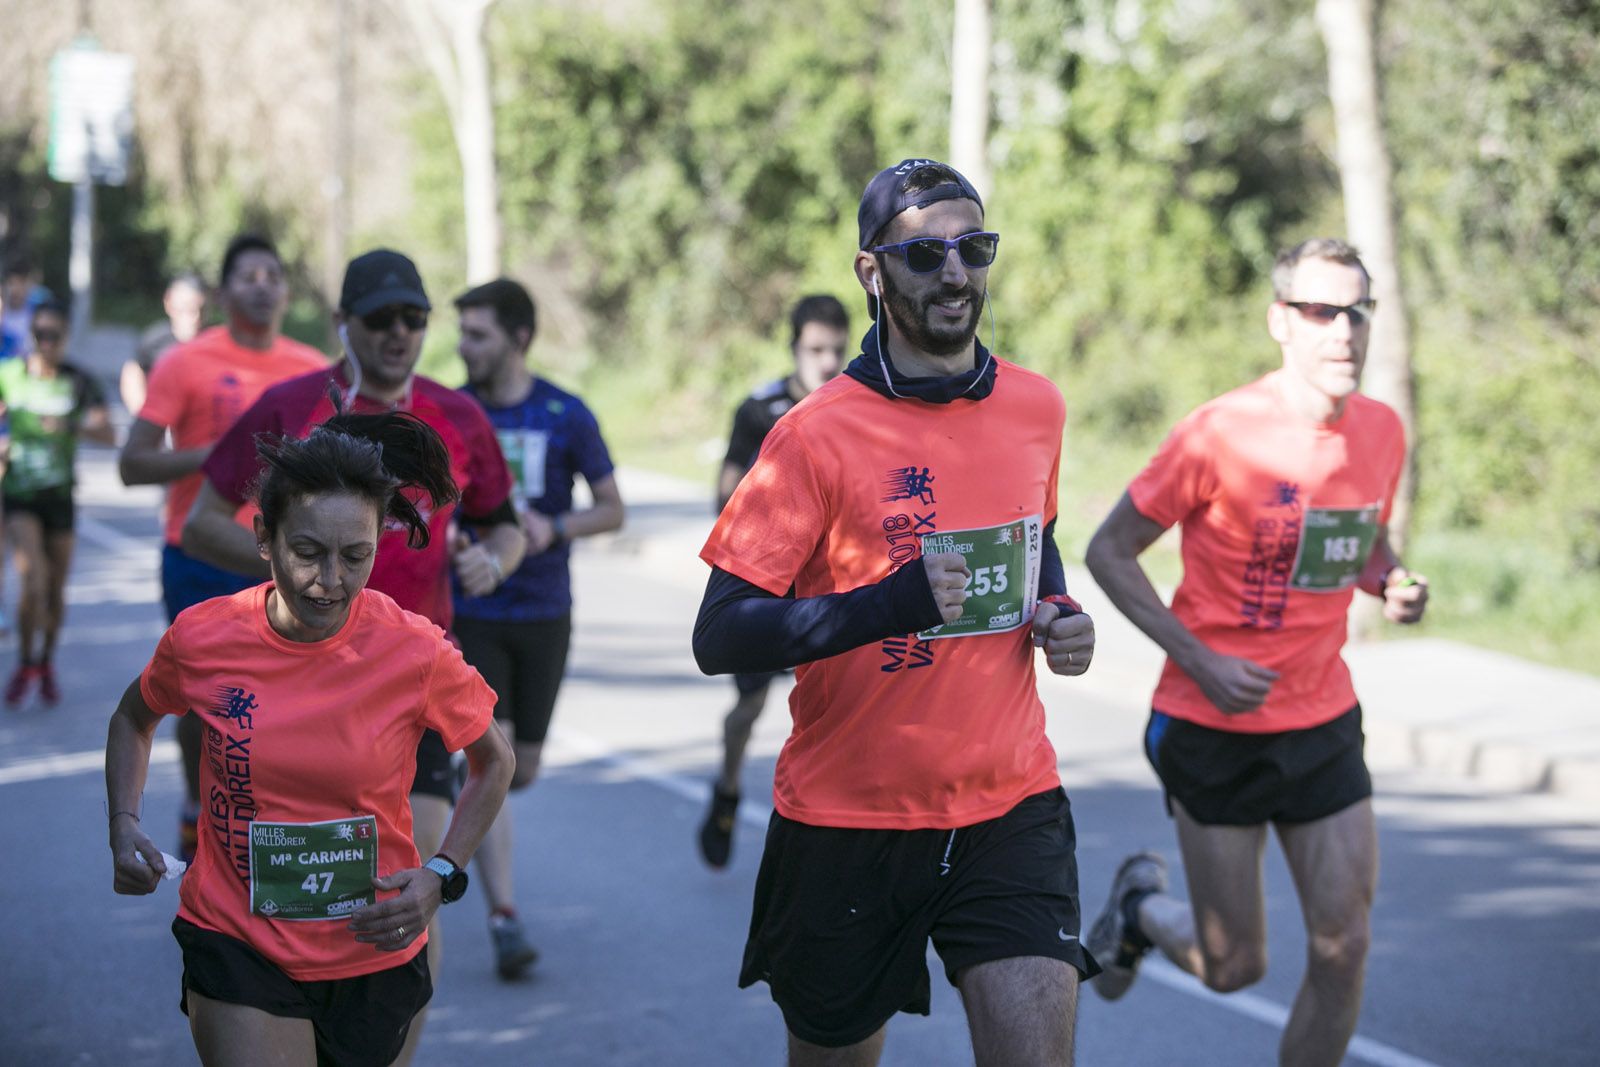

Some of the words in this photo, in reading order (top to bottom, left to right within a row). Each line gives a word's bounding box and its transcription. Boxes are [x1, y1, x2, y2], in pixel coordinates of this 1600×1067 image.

[925, 535, 954, 547] MILLES
[1029, 523, 1038, 552] 253
[1323, 536, 1360, 562] 163
[253, 827, 285, 838] MILLES
[254, 836, 306, 847] VALLDOREIX
[298, 848, 364, 865] CARMEN
[301, 871, 335, 895] 47
[327, 897, 368, 912] COMPLEX
